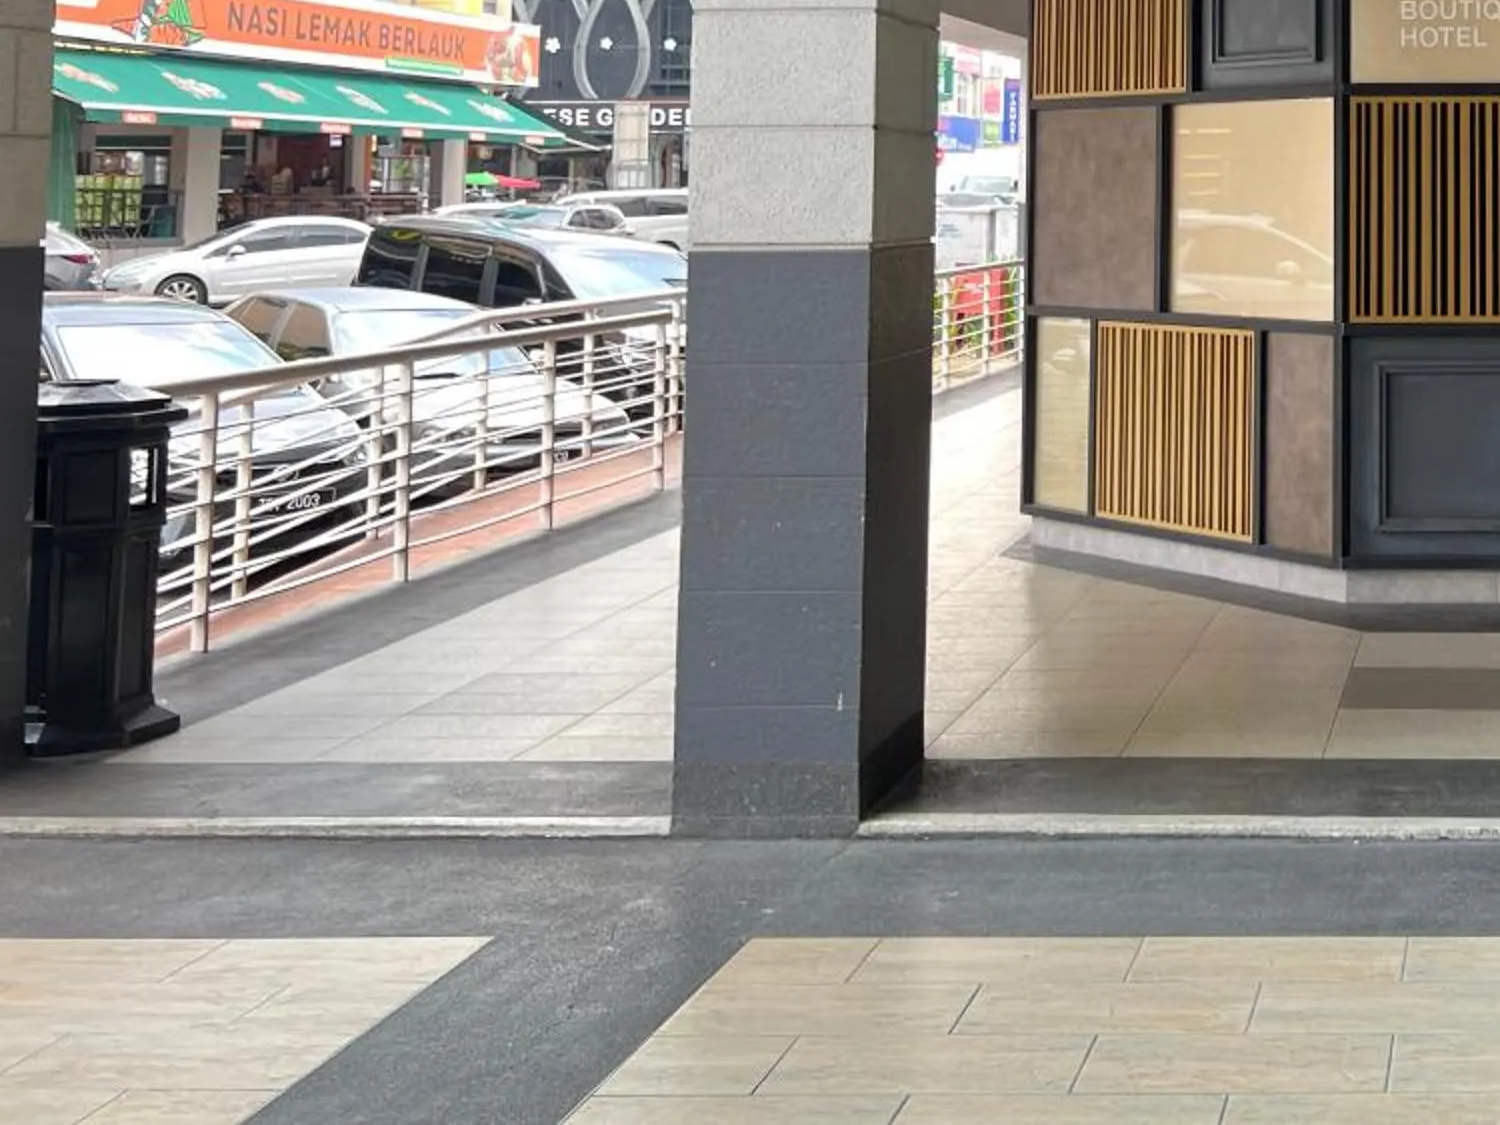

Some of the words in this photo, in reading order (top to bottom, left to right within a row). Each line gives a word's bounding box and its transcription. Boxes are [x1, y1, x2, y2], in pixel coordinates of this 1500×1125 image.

[228, 1, 287, 37] NASI
[296, 14, 371, 48] LEMAK
[378, 23, 466, 60] BERLAUK
[1400, 26, 1489, 48] HOTEL
